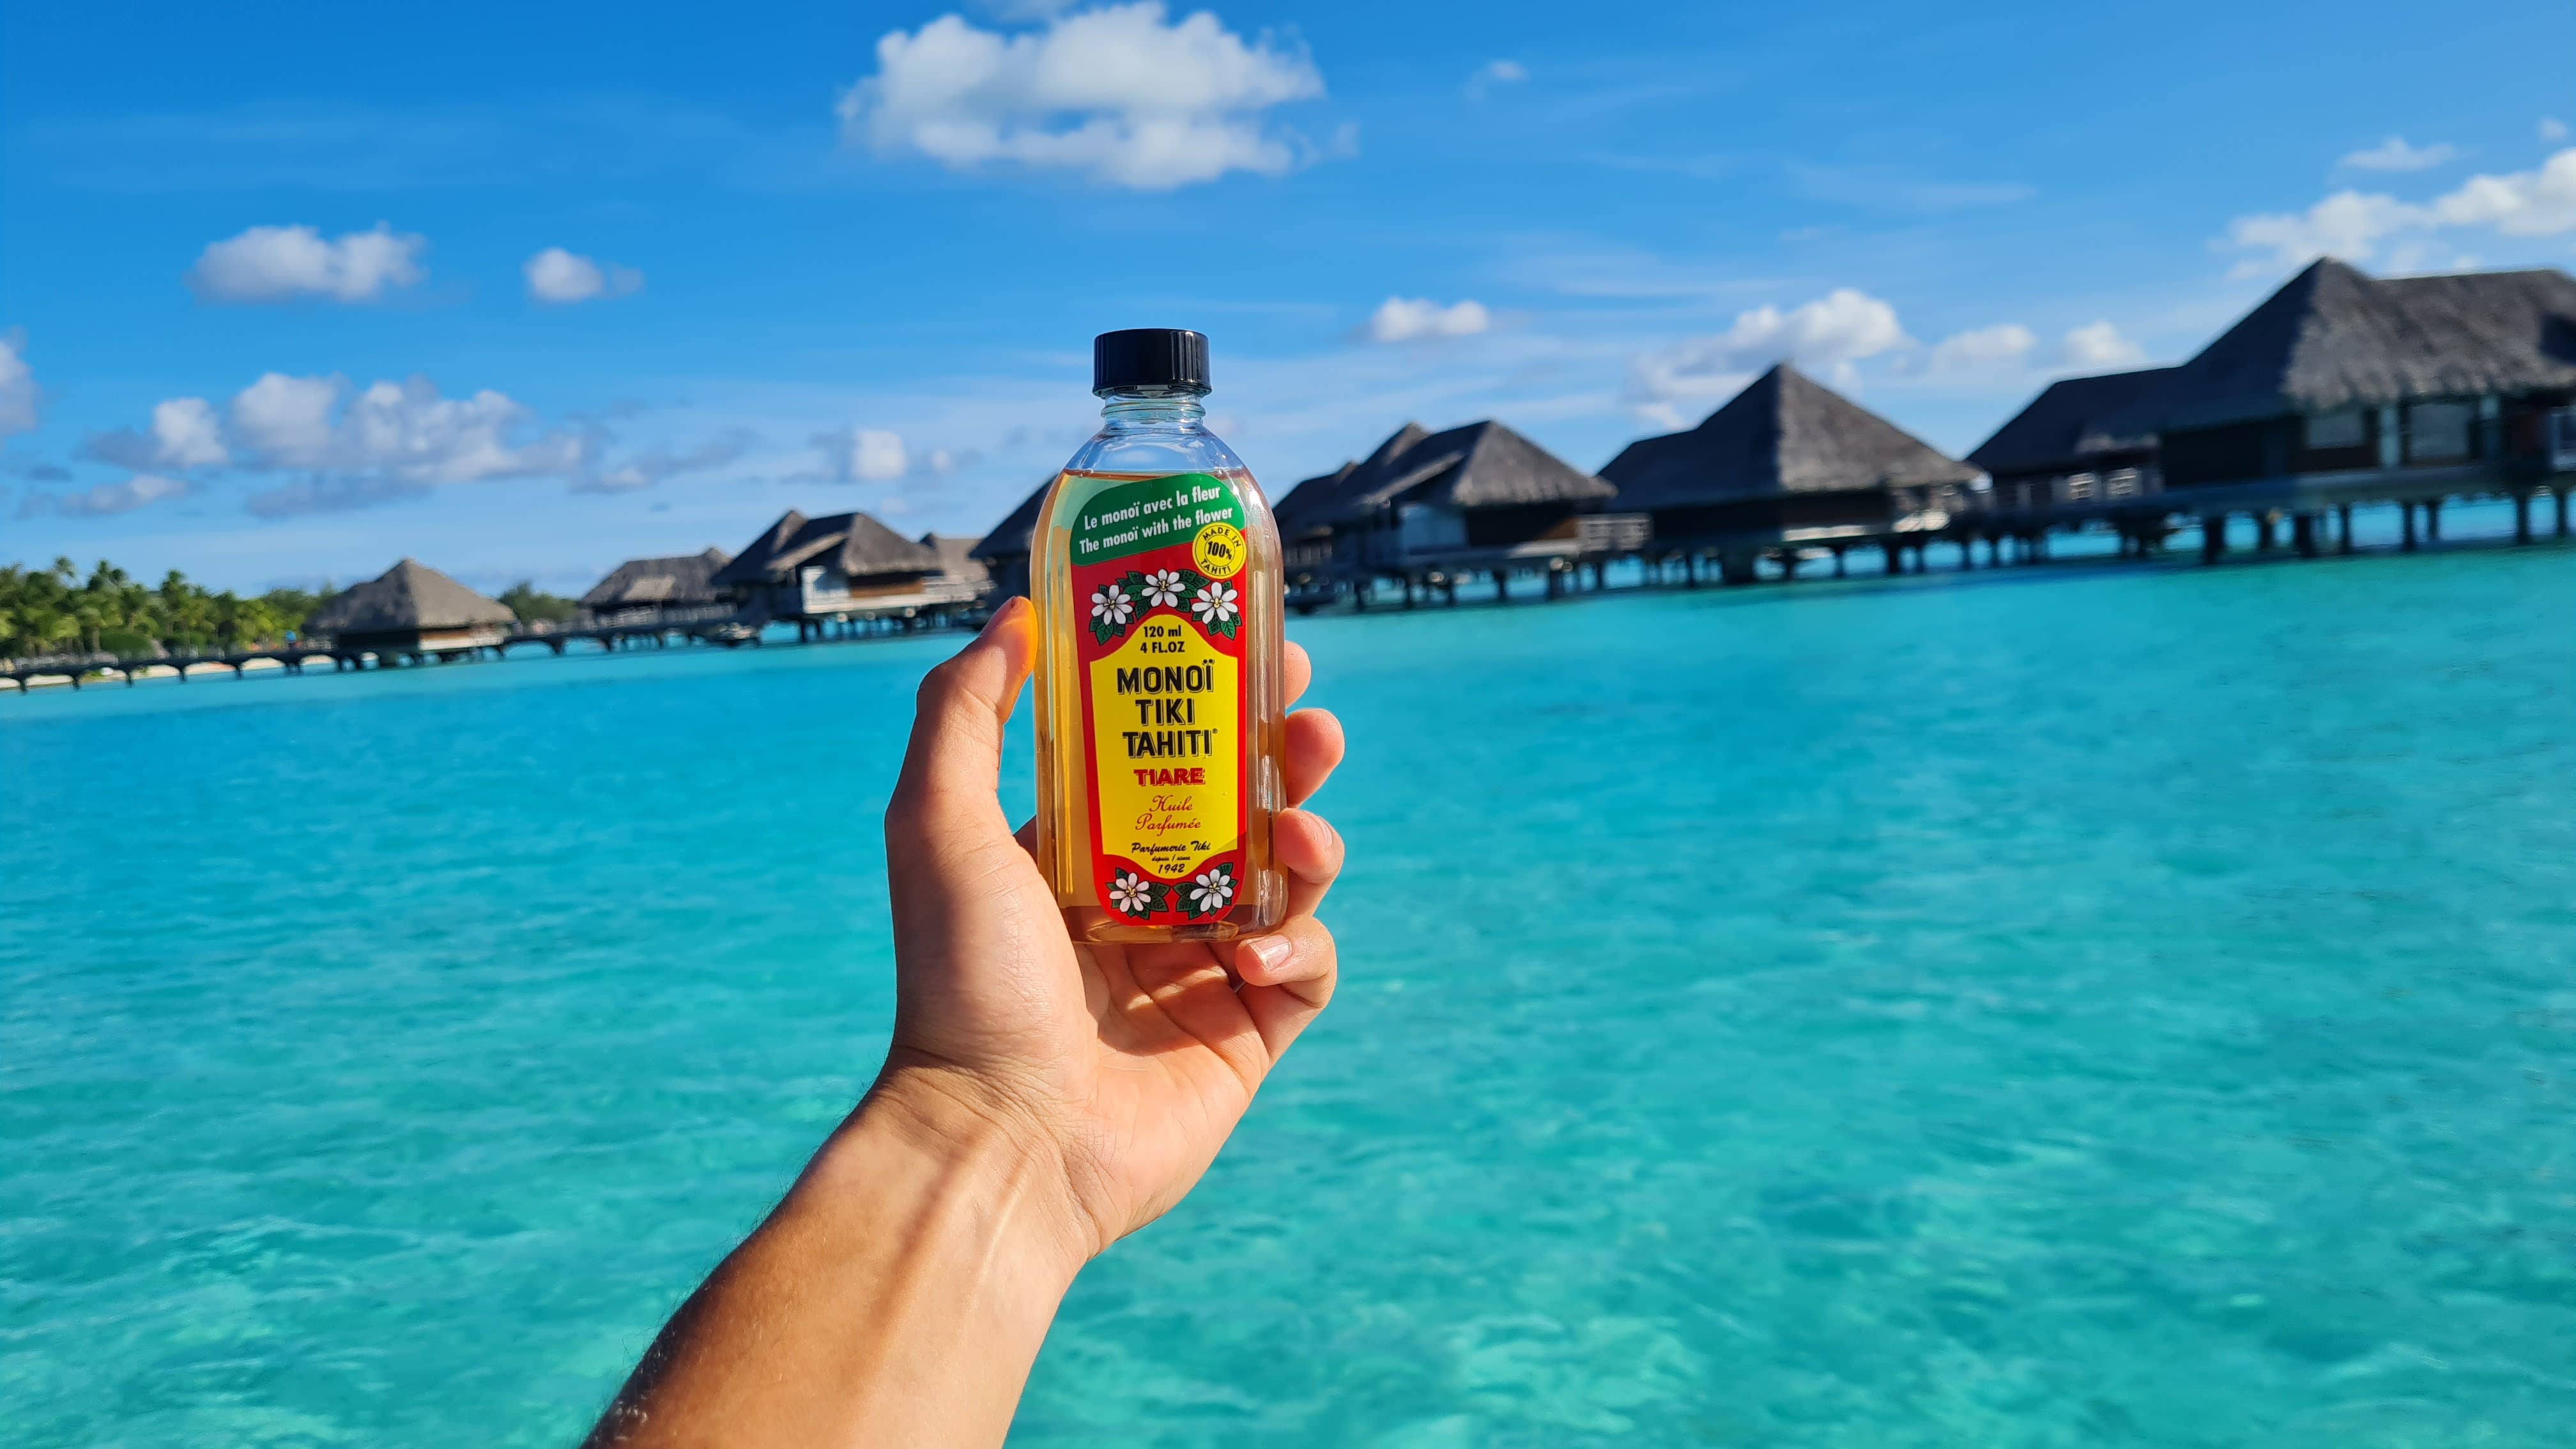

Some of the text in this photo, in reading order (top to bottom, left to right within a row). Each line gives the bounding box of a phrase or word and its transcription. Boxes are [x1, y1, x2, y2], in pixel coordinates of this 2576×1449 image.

[1084, 486, 1221, 531] Le monoï avec la fleur
[1079, 507, 1233, 555] The monoï with the flower
[1202, 526, 1242, 548] MADE IN
[1207, 540, 1233, 560] 100%
[1200, 558, 1232, 575] TAHITI
[1143, 624, 1182, 638] 120 ml
[1140, 641, 1185, 654] 4 FL.OZ
[1117, 659, 1215, 695] MONOÏ
[1135, 698, 1195, 726] TIKI
[1133, 767, 1206, 786] TIARE
[1149, 795, 1193, 813] Huile
[1135, 813, 1202, 837] Parfumée
[1131, 840, 1211, 855] Parfumerie Tiki
[1158, 863, 1185, 874] 1942
